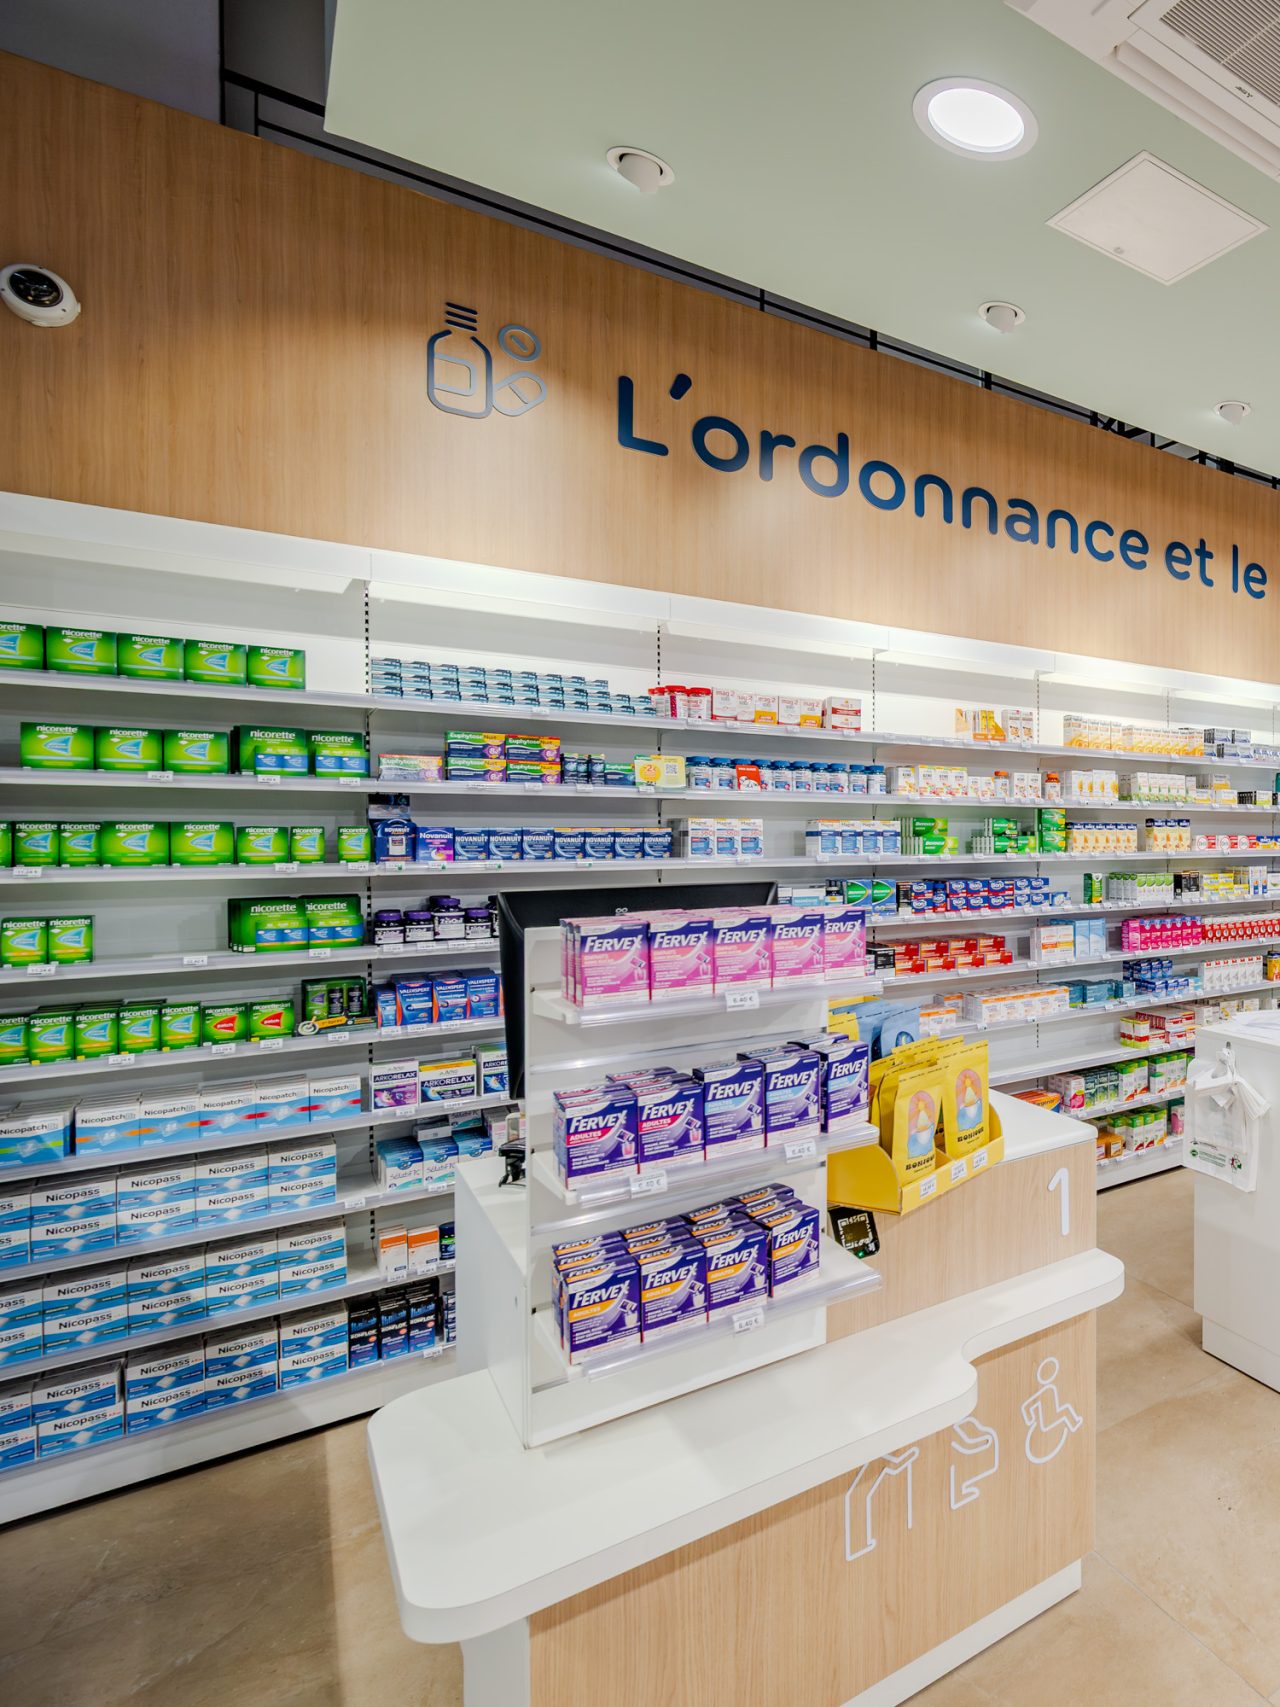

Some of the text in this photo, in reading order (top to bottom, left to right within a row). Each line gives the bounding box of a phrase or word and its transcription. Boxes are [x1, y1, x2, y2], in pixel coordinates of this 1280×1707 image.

[617, 372, 1150, 571] L'ordonnance
[1164, 538, 1213, 589] et
[1231, 544, 1266, 599] le
[62, 629, 102, 638] nicorette
[132, 635, 170, 645] nicorette
[198, 642, 234, 651] nicorette
[260, 648, 294, 656] nicorette
[36, 725, 78, 734] nicorette
[110, 729, 149, 737] nicorette
[178, 731, 214, 739] nicorette
[250, 729, 296, 740] nicorette
[312, 734, 354, 743] nicorette
[419, 831, 453, 839] Novanuit
[251, 903, 296, 913] nicorette
[3, 920, 46, 928] nicorette
[50, 918, 91, 927] nicorette
[716, 927, 767, 944] FERVEX
[774, 923, 821, 940] FERVEX
[584, 934, 643, 953] FERVEX
[653, 930, 708, 949] FERVEX
[120, 1008, 158, 1018] nicorette
[161, 1004, 200, 1014] nicorette
[31, 1015, 72, 1025] nicorette
[76, 1012, 116, 1022] nicorette
[830, 1056, 868, 1080] FERVEX
[769, 1067, 818, 1090] FERVEX
[708, 1077, 762, 1101] FERVEX
[642, 1098, 695, 1120] FERVEX
[570, 1110, 627, 1134] FERVEX
[642, 1118, 671, 1128] ADULTES
[570, 1130, 601, 1141] ADULTES
[280, 1150, 323, 1163] Nicopass
[209, 1162, 255, 1175] Nicopass
[131, 1174, 181, 1188] Nicopass
[280, 1179, 323, 1193] Nicopass
[46, 1187, 100, 1202] Nicopass
[208, 1192, 255, 1206] Nicopass
[1048, 1167, 1070, 1236] 1
[130, 1205, 181, 1220] Nicopass
[45, 1221, 100, 1236] Nicopass
[775, 1221, 814, 1248] FERVEX
[289, 1233, 332, 1248] Nicopass
[218, 1248, 264, 1263] Nicopass
[710, 1244, 759, 1270] FERVEX
[141, 1263, 190, 1279] Nicopass
[291, 1263, 334, 1277] Nicopass
[645, 1262, 698, 1289] FERVEX
[57, 1279, 111, 1296] Nicopass
[219, 1278, 265, 1294] Nicopass
[573, 1280, 630, 1309] FERVEX
[142, 1294, 191, 1311] Nicopass
[58, 1312, 112, 1330] Nicopass
[292, 1319, 336, 1335] Nicopass
[218, 1338, 264, 1355] Nicopass
[292, 1350, 335, 1366] Nicopass
[140, 1357, 190, 1375] Nicopass
[216, 1369, 263, 1387] Nicopass
[47, 1380, 100, 1399] Nicopass
[141, 1389, 191, 1408] Nicopass
[53, 1412, 107, 1431] Nicopass
